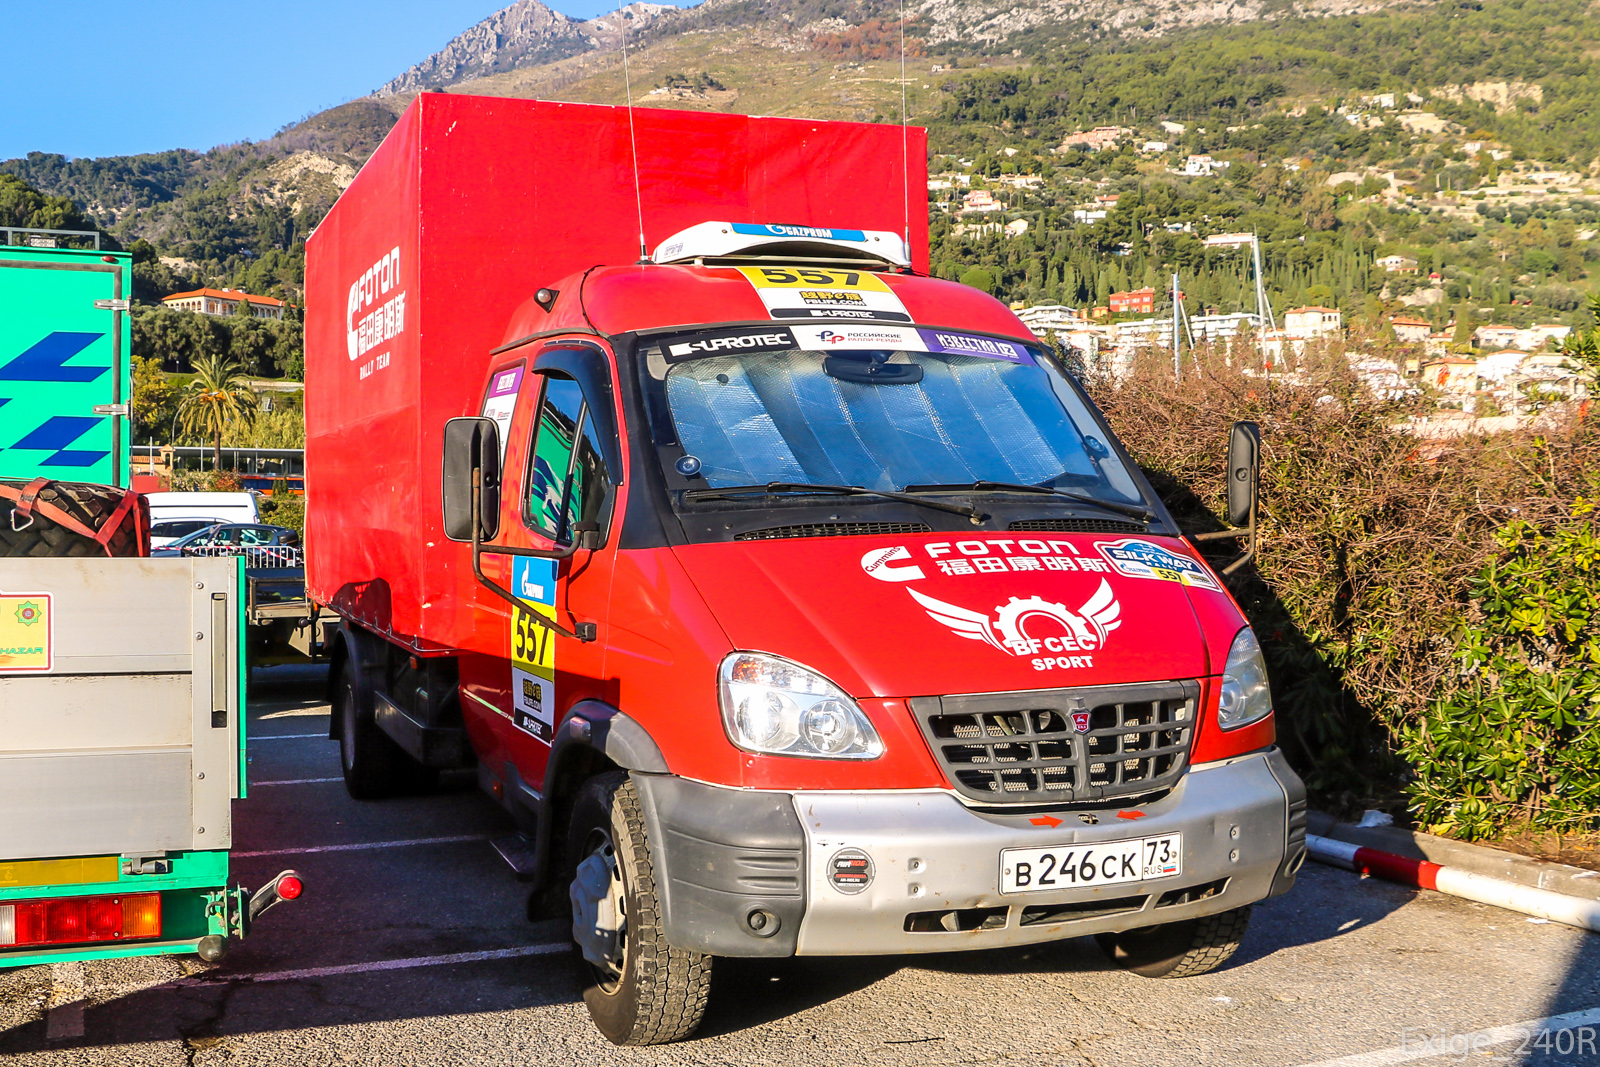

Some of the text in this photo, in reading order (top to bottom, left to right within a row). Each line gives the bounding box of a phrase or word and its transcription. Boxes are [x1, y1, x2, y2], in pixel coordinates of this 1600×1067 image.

[787, 226, 833, 239] GAZPROM
[358, 246, 400, 313] FOTON
[760, 268, 860, 286] 557
[358, 291, 406, 357] 福田康明斯
[810, 310, 875, 318] SUPROTEC
[669, 333, 791, 357] SUPROTEC
[935, 333, 999, 354] ИЗВЕСТИЯ
[359, 351, 390, 381] RALLY TEAM
[925, 540, 1080, 557] FOTON
[864, 547, 901, 573] Cummins
[939, 556, 1112, 577] 福田康明斯
[1112, 550, 1158, 563] SILK
[1156, 555, 1193, 570] WAY
[1145, 561, 1178, 571] RALLY
[1157, 569, 1182, 581] 557
[516, 608, 549, 666] 557
[1031, 656, 1094, 671] SPORT
[1146, 839, 1171, 866] 73
[1143, 864, 1162, 876] RUS
